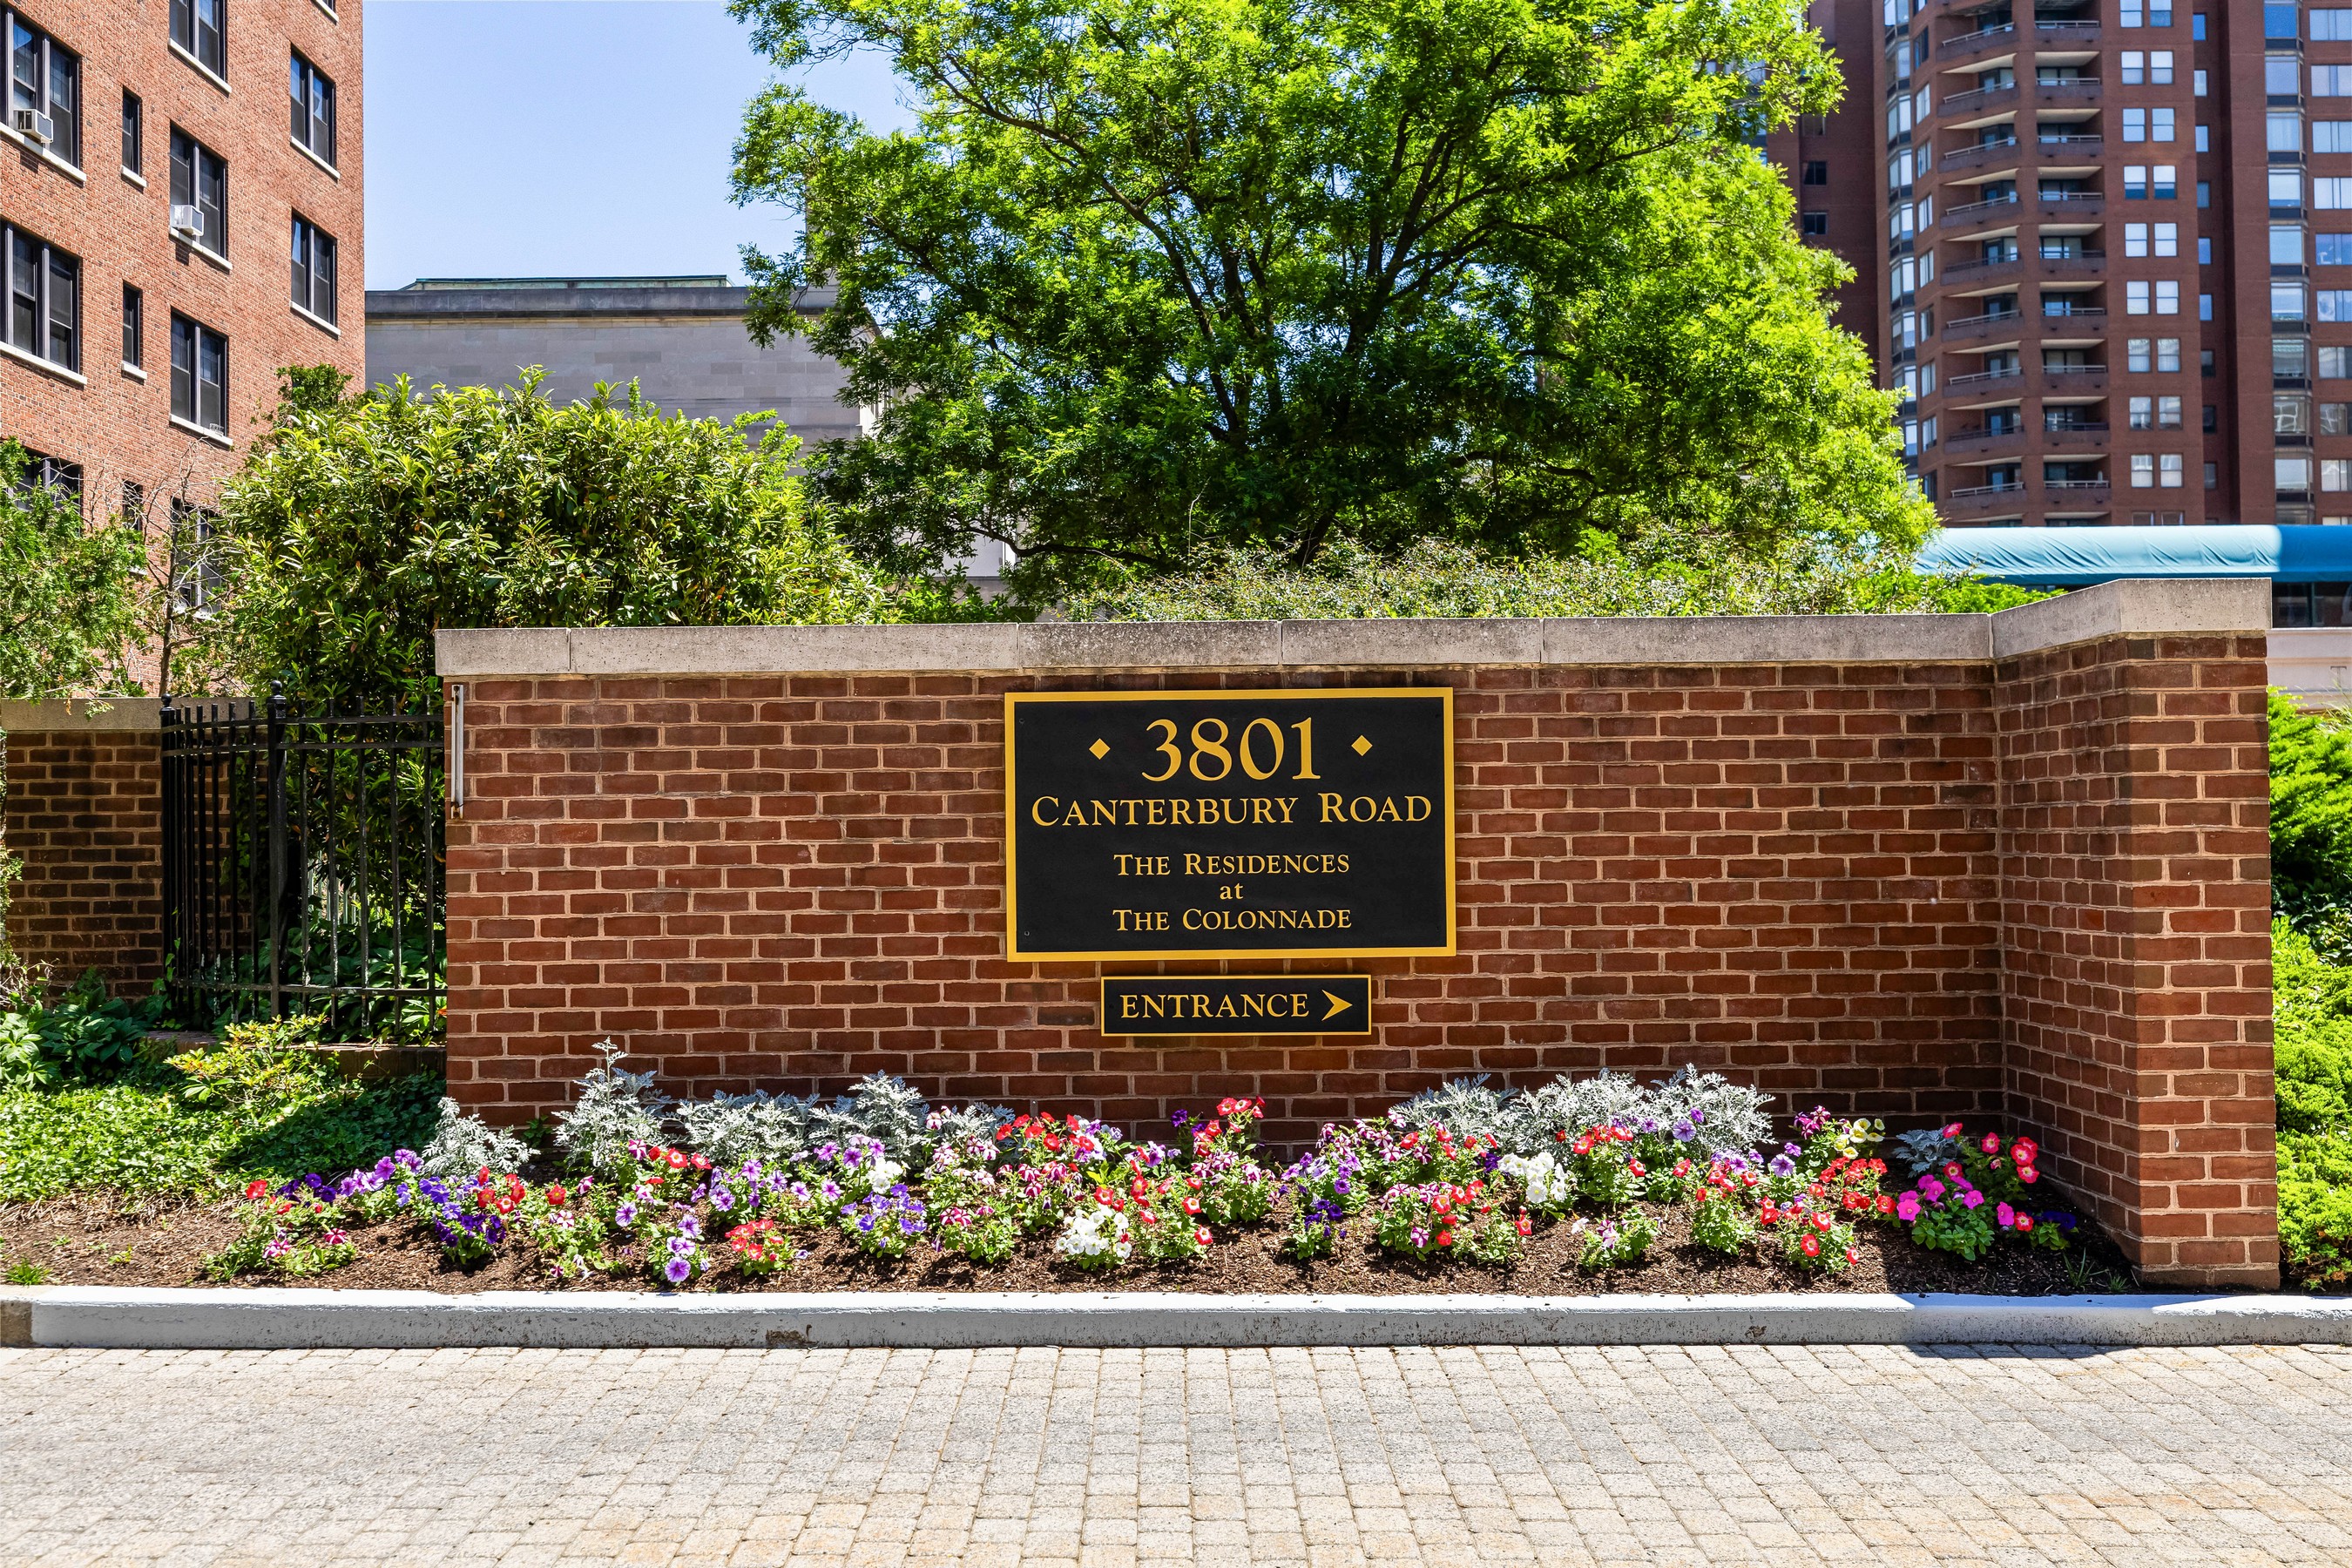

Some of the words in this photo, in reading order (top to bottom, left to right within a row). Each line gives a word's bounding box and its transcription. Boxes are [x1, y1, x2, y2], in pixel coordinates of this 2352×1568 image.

[1141, 716, 1321, 782] 3801
[1031, 795, 1299, 827] CANTERBURY
[1317, 792, 1431, 823] ROAD
[1113, 854, 1171, 876] THE
[1183, 853, 1349, 875] RESIDENCES
[1220, 882, 1244, 900] at
[1112, 909, 1170, 931] THE
[1182, 909, 1352, 931] COLONNADE
[1119, 993, 1309, 1018] ENTRANCE
